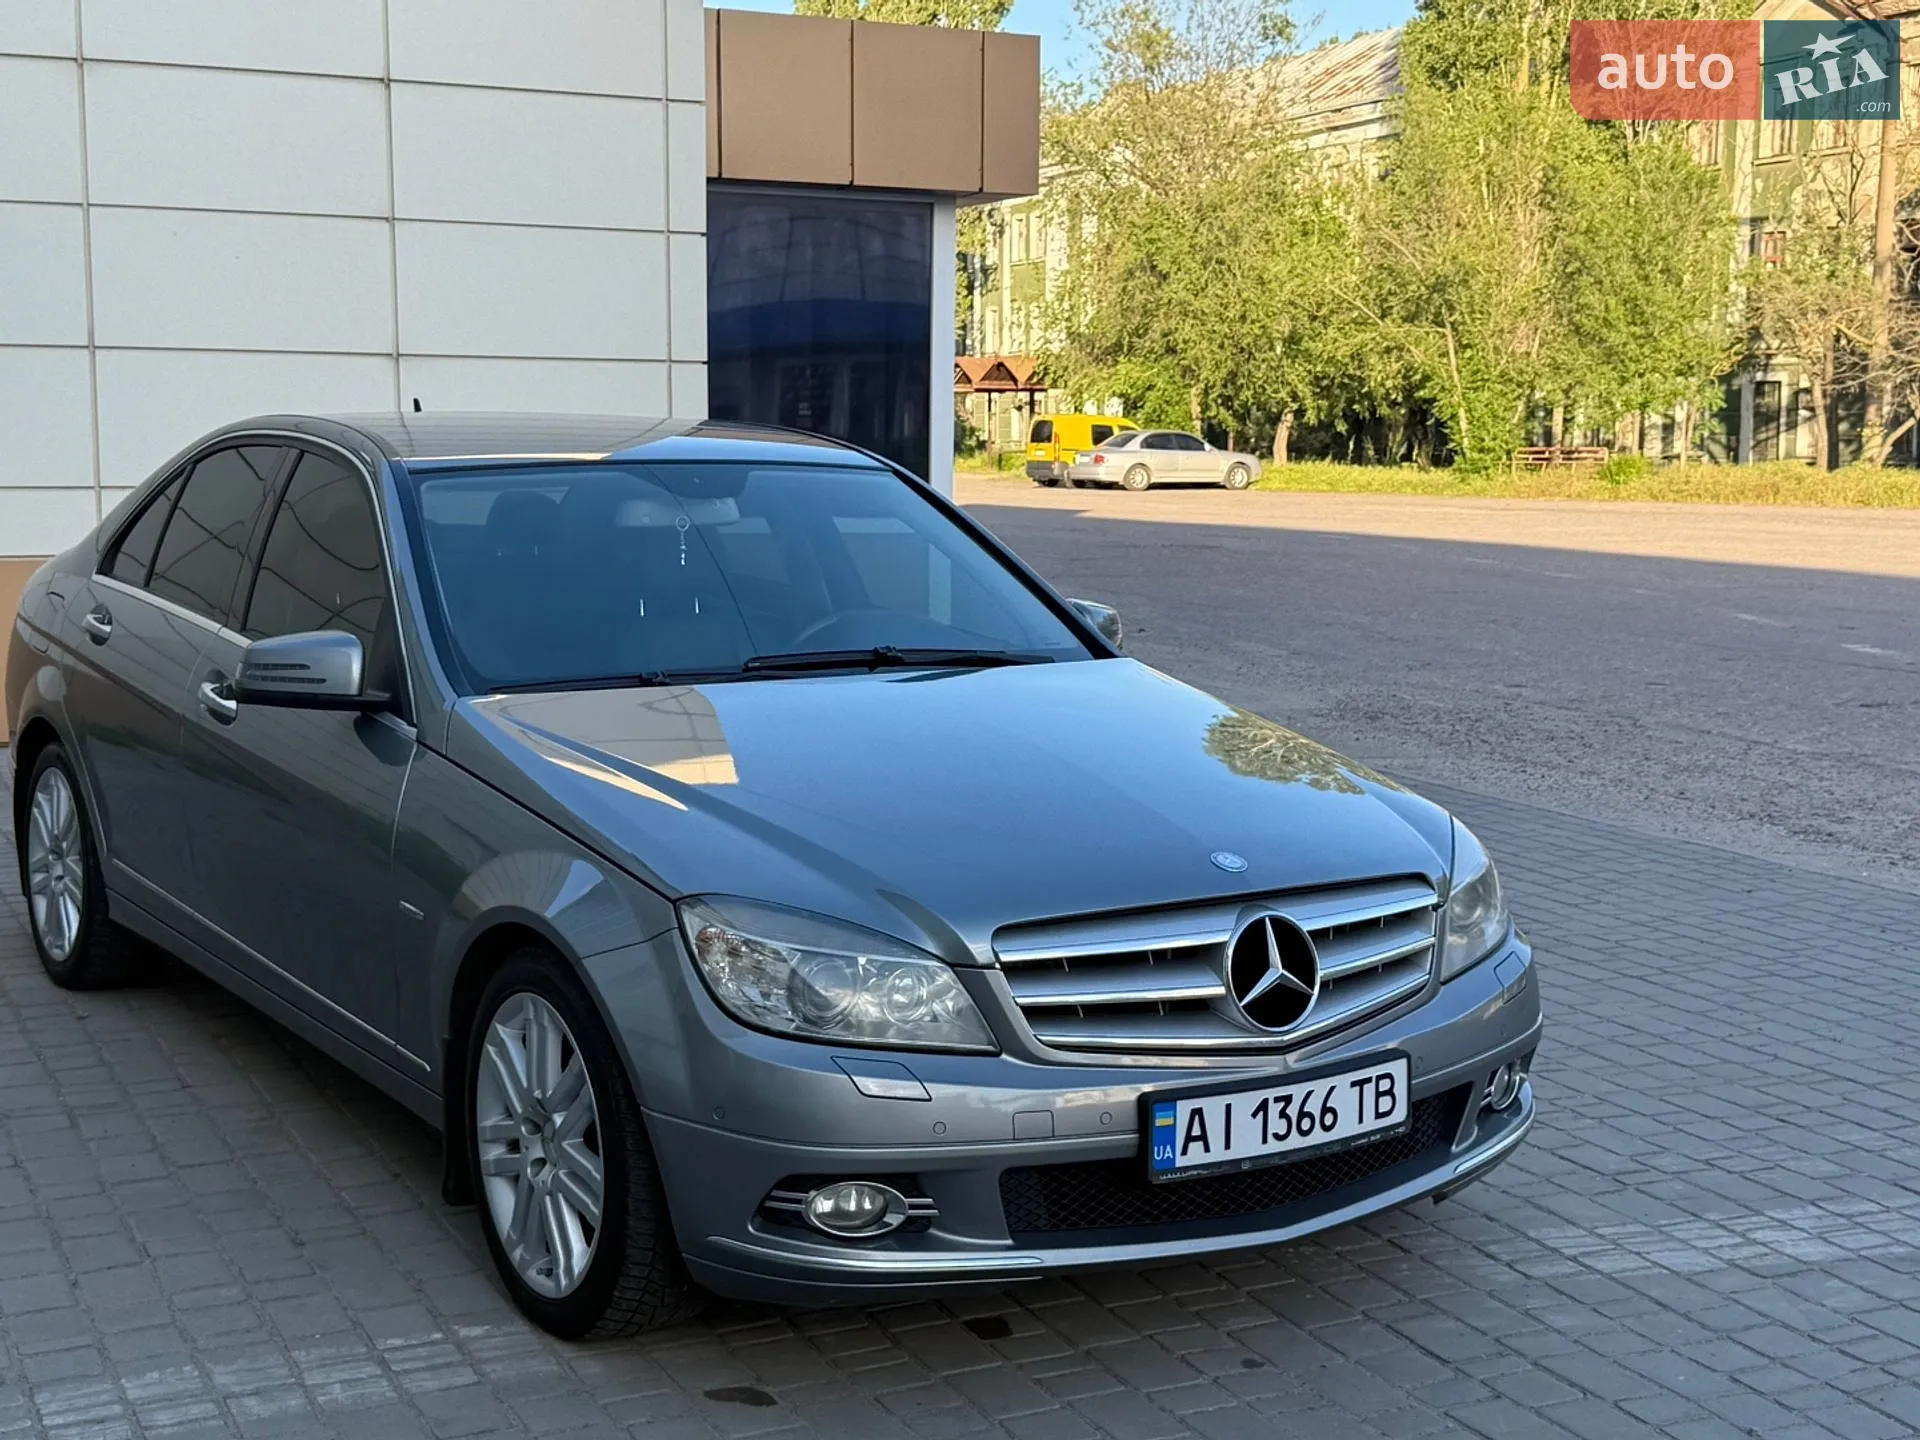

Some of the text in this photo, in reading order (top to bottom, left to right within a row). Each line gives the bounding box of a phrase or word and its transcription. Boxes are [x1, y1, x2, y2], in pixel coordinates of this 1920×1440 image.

[1180, 1071, 1397, 1156] AI 1366 TB
[1154, 1145, 1174, 1160] UA
